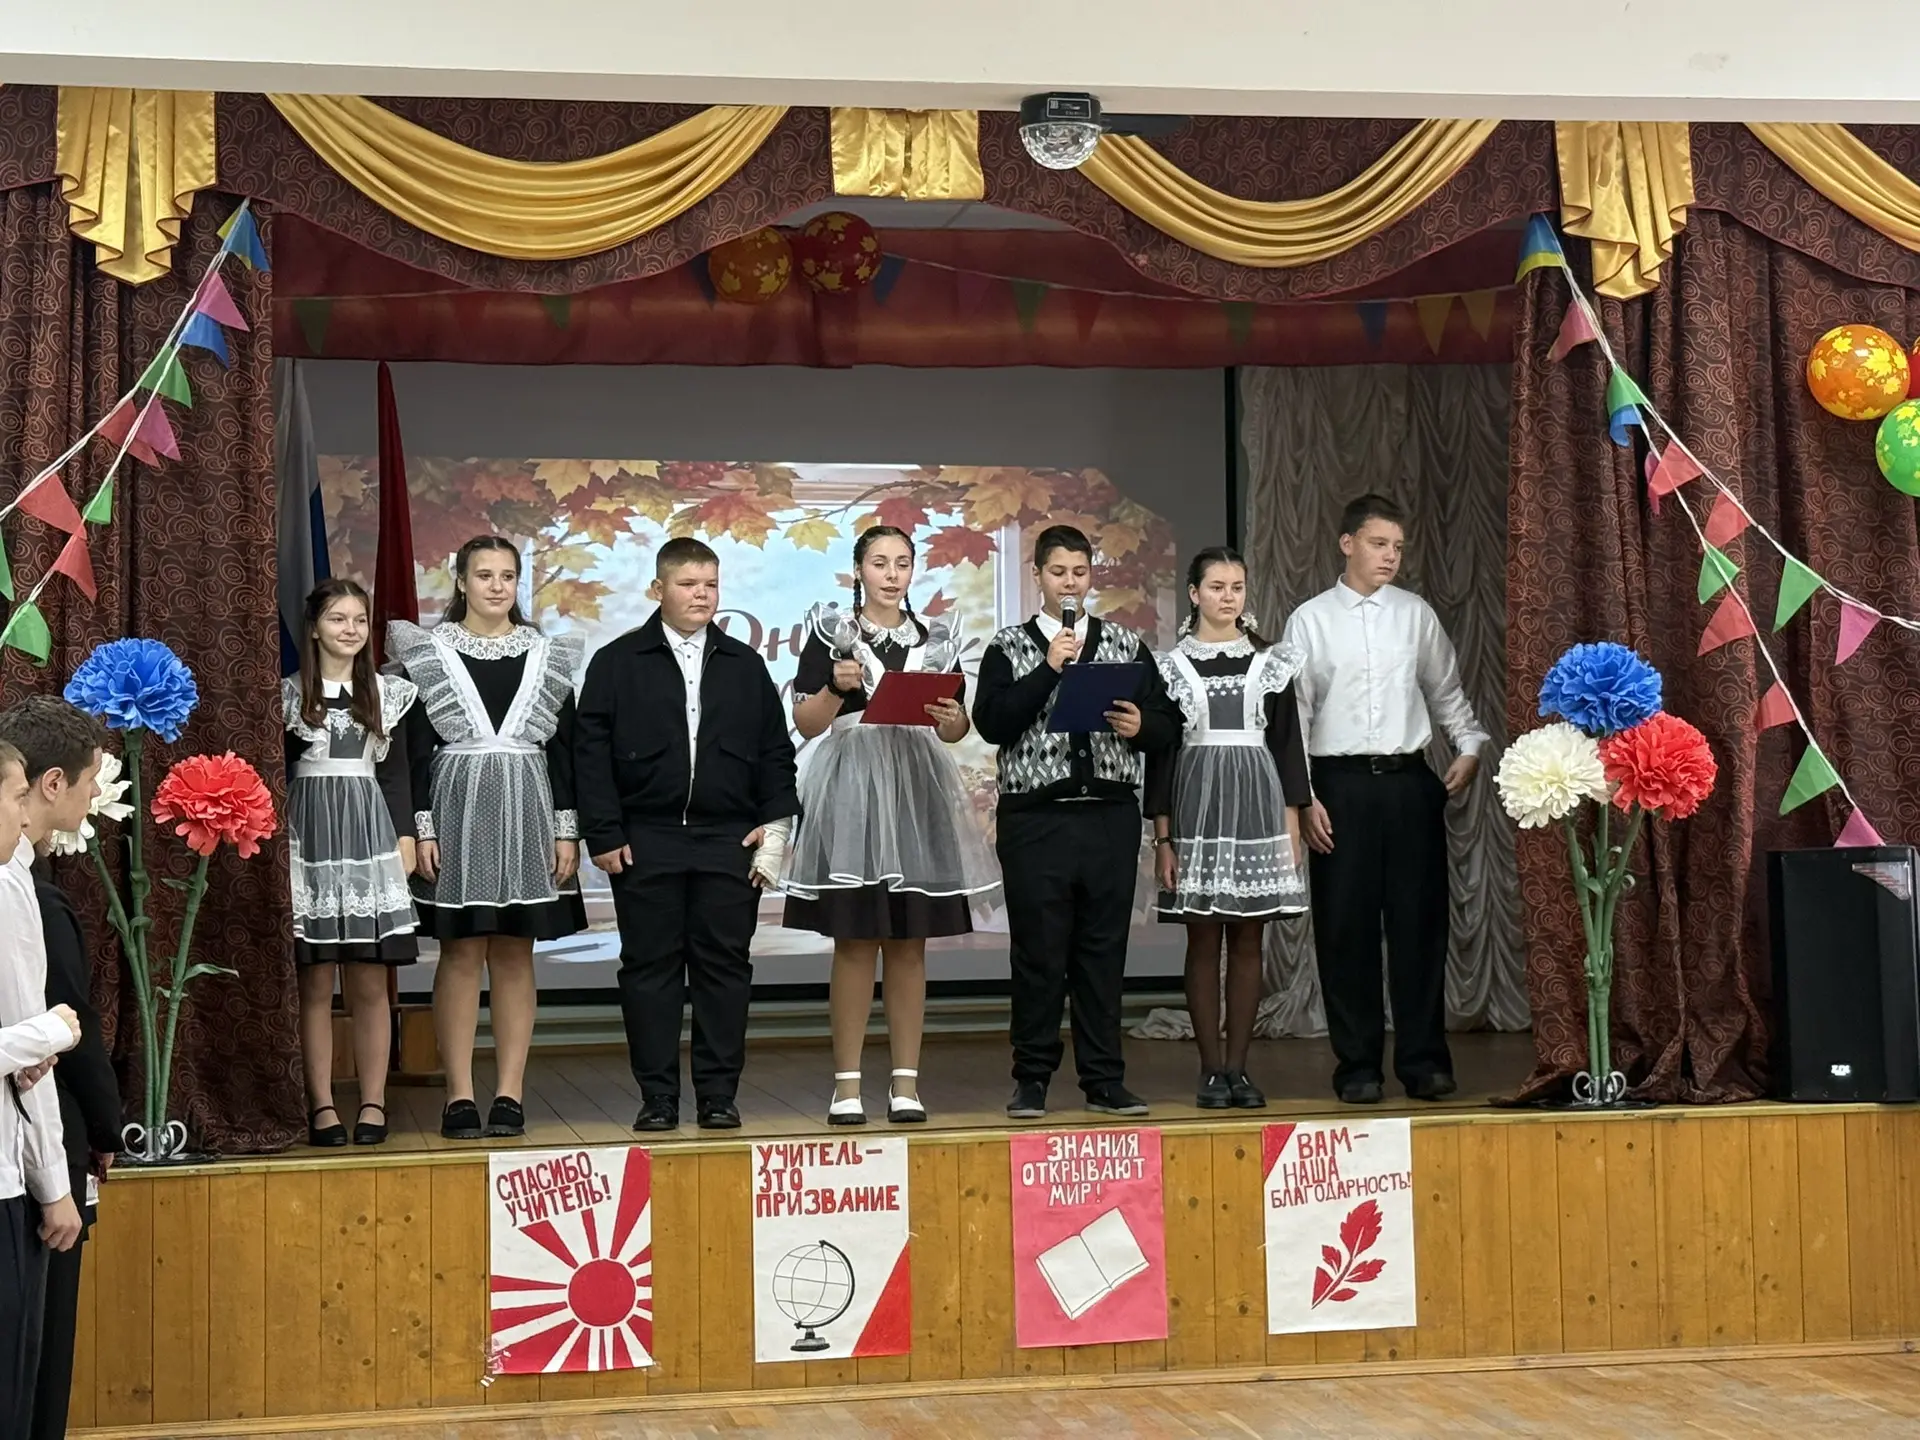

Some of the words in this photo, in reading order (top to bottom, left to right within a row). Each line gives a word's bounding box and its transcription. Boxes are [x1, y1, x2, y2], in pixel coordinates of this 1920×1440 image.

[1046, 1133, 1139, 1161] ЗНАНИЯ
[758, 1168, 803, 1193] ЭТО
[1022, 1157, 1146, 1186] ОТКРЫВАЮТ
[1283, 1156, 1340, 1189] НАША
[504, 1174, 612, 1227] УЧИТЕЛЬ!
[756, 1185, 900, 1218] ПРИЗВАНИЕ
[1048, 1182, 1101, 1207] МИР!
[1271, 1171, 1412, 1209] БЛАГОДАРНОСТЬ!
